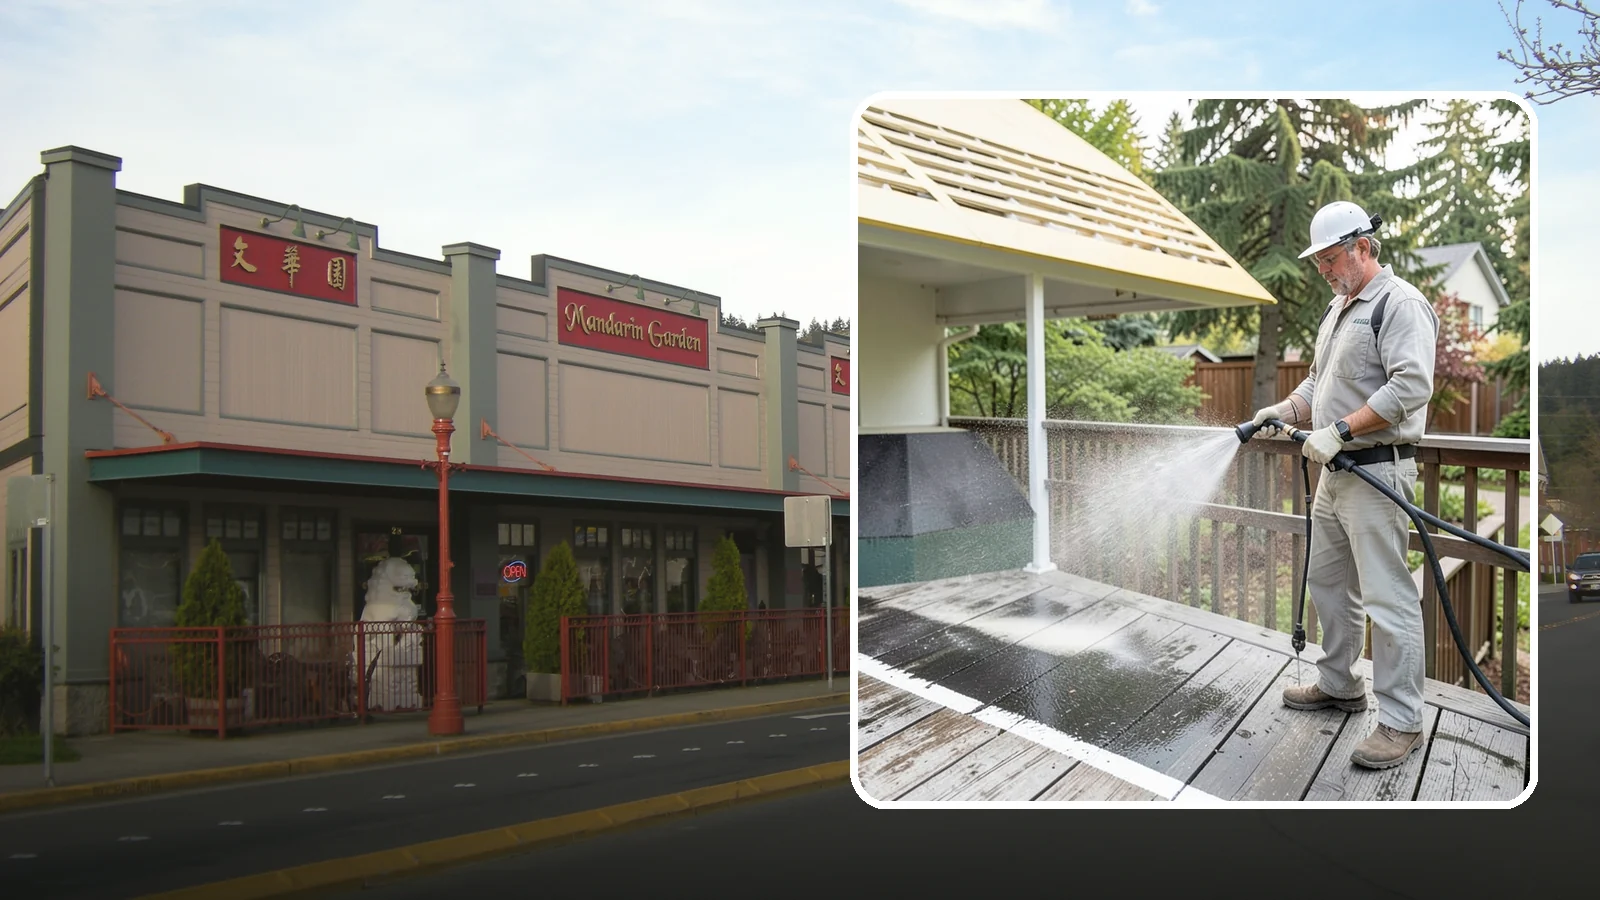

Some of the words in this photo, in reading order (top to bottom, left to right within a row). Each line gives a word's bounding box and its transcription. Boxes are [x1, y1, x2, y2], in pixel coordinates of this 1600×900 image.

[564, 302, 644, 341] Mandarin
[648, 320, 702, 352] Garden
[503, 565, 526, 578] OPEN
